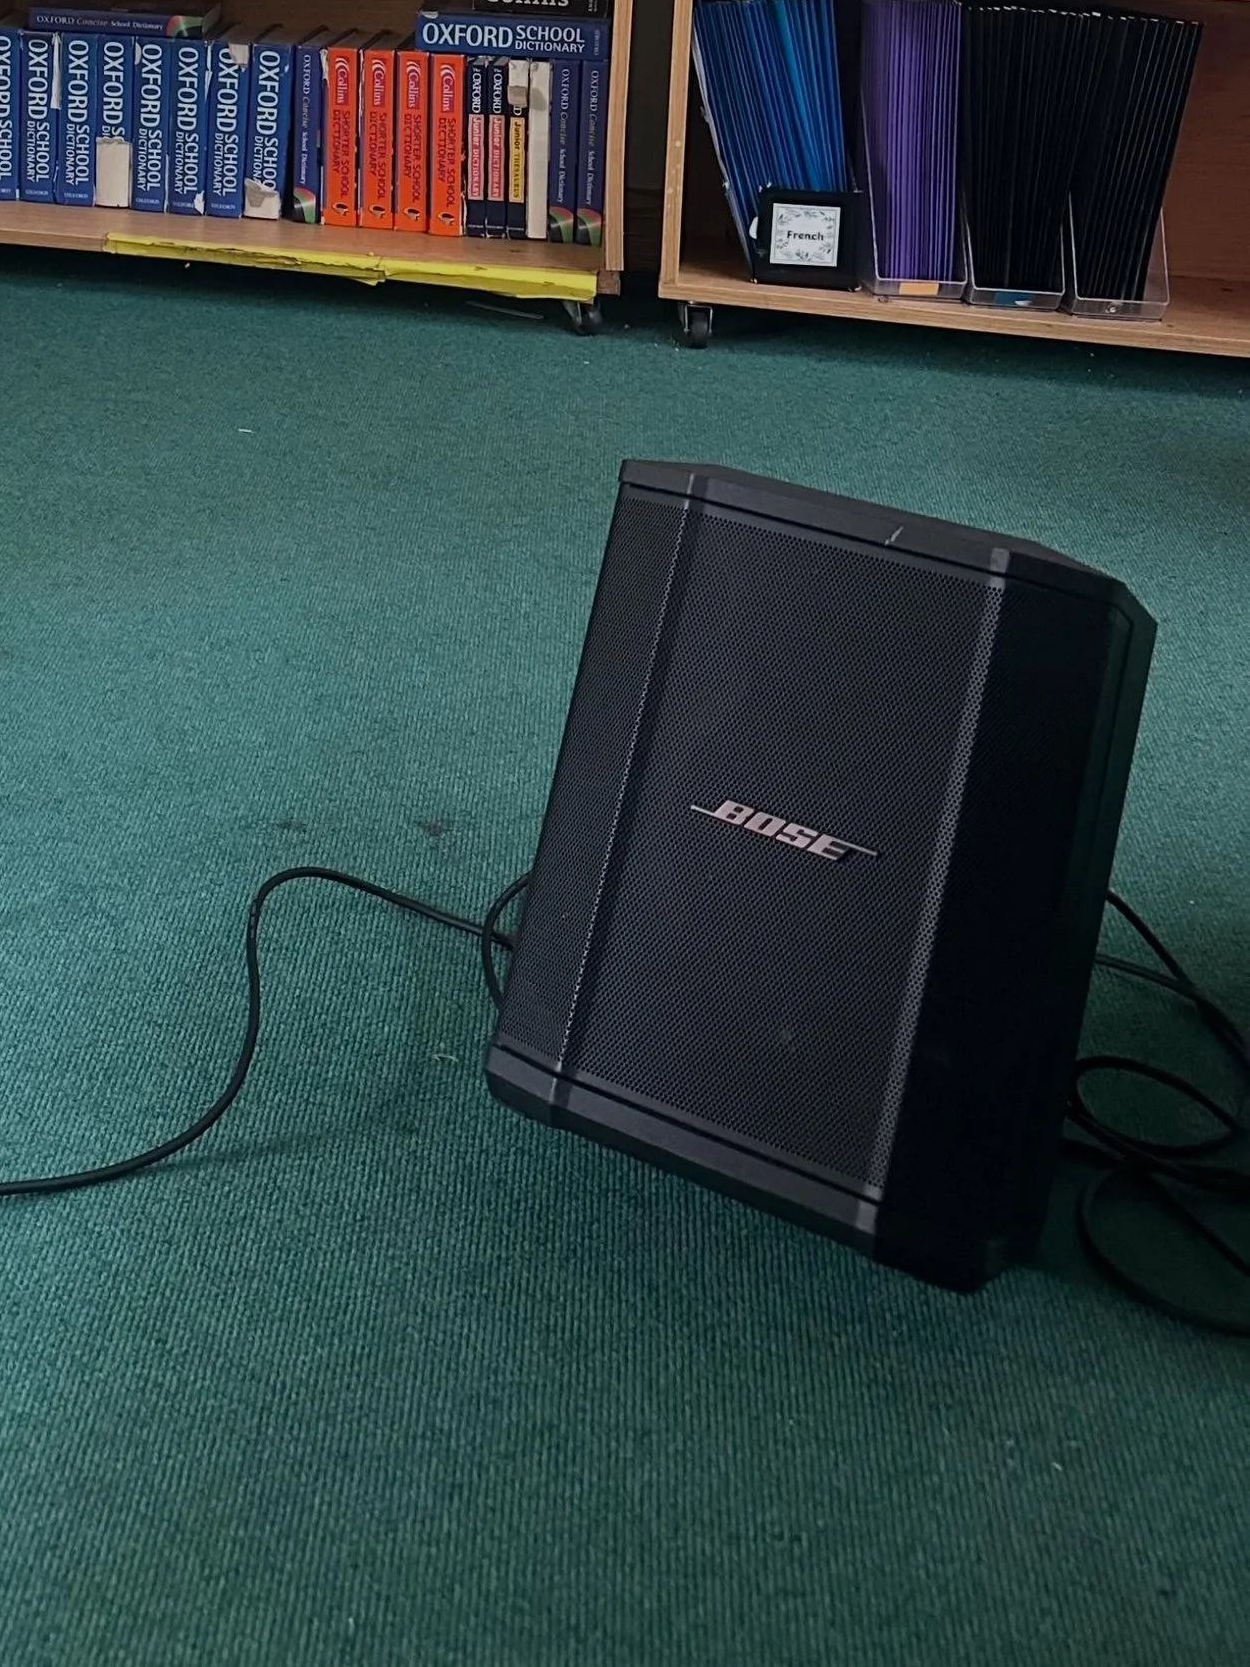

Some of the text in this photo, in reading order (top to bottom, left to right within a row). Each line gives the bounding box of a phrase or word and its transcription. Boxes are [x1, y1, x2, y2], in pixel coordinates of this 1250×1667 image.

[36, 15, 75, 25] OXFORD
[111, 19, 131, 28] School
[132, 21, 163, 31] Dictionary
[422, 22, 513, 48] OXFORD
[514, 40, 586, 54] DICTIONARY
[515, 24, 585, 43] SCHOOL
[27, 39, 49, 120] OXFORD
[67, 39, 89, 123] OXFORD
[102, 41, 125, 127] OXFORD
[140, 43, 162, 128] OXFORD
[176, 46, 198, 131] OXFORD
[256, 50, 281, 135] OXFORD
[302, 54, 311, 94] OXFORD
[336, 68, 347, 104] Collins
[373, 69, 385, 106] Collins
[408, 71, 419, 109] Collins
[442, 75, 453, 112] Collins
[471, 72, 482, 114] OXFORD
[492, 72, 503, 114] OXFORD
[560, 68, 570, 110] OXFORD
[590, 70, 599, 112] OXFORD
[26, 120, 36, 182] DICTIONARY
[35, 119, 50, 183] SCHOOL
[65, 123, 76, 186] DICTIONARY
[75, 121, 90, 186] SCHOOL
[137, 128, 147, 191] DICTIONARY
[146, 128, 162, 191] SCHOOL
[175, 131, 184, 195] DICTIONARY
[183, 131, 198, 195] SCHOOL
[213, 132, 223, 197] DICTIONARY
[222, 133, 238, 197] SCHOOL
[332, 109, 341, 173] DICTIONARY
[340, 110, 350, 197] SHORTER SCHOOL
[369, 111, 378, 177] DICTIONARY
[377, 112, 387, 200] SHORTER SCHOOL
[513, 121, 522, 150] Junior
[785, 229, 825, 243] French
[691, 799, 878, 861] BOSE
